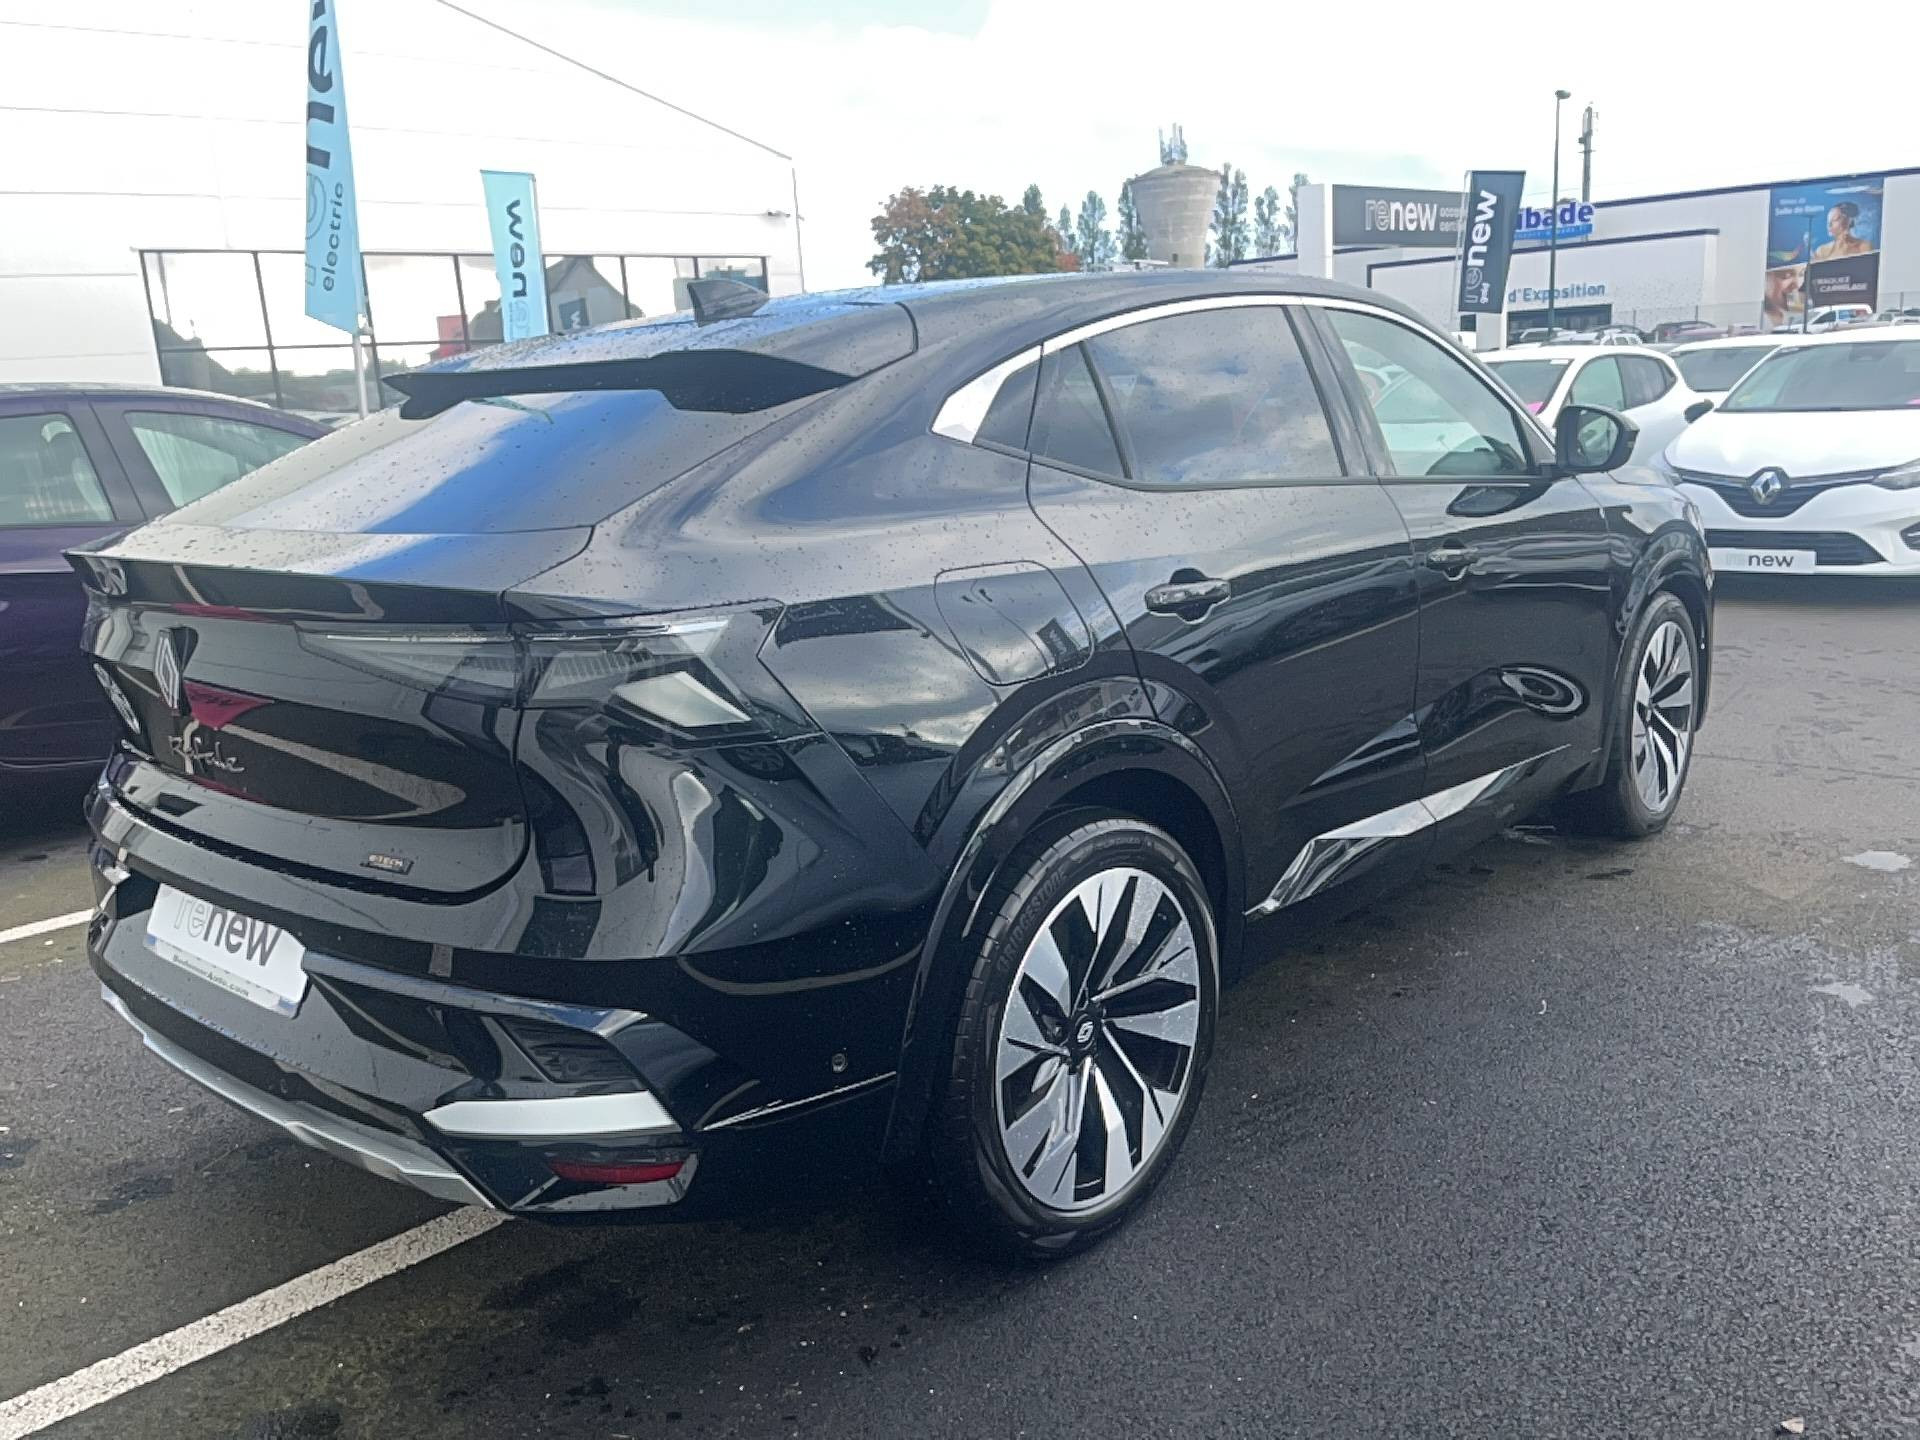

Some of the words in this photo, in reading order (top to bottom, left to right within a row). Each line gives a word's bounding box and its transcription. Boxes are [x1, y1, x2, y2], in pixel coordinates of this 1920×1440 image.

[321, 181, 344, 292] electric
[1365, 199, 1438, 231] renew
[1465, 190, 1498, 304] renew
[174, 896, 283, 967] renew
